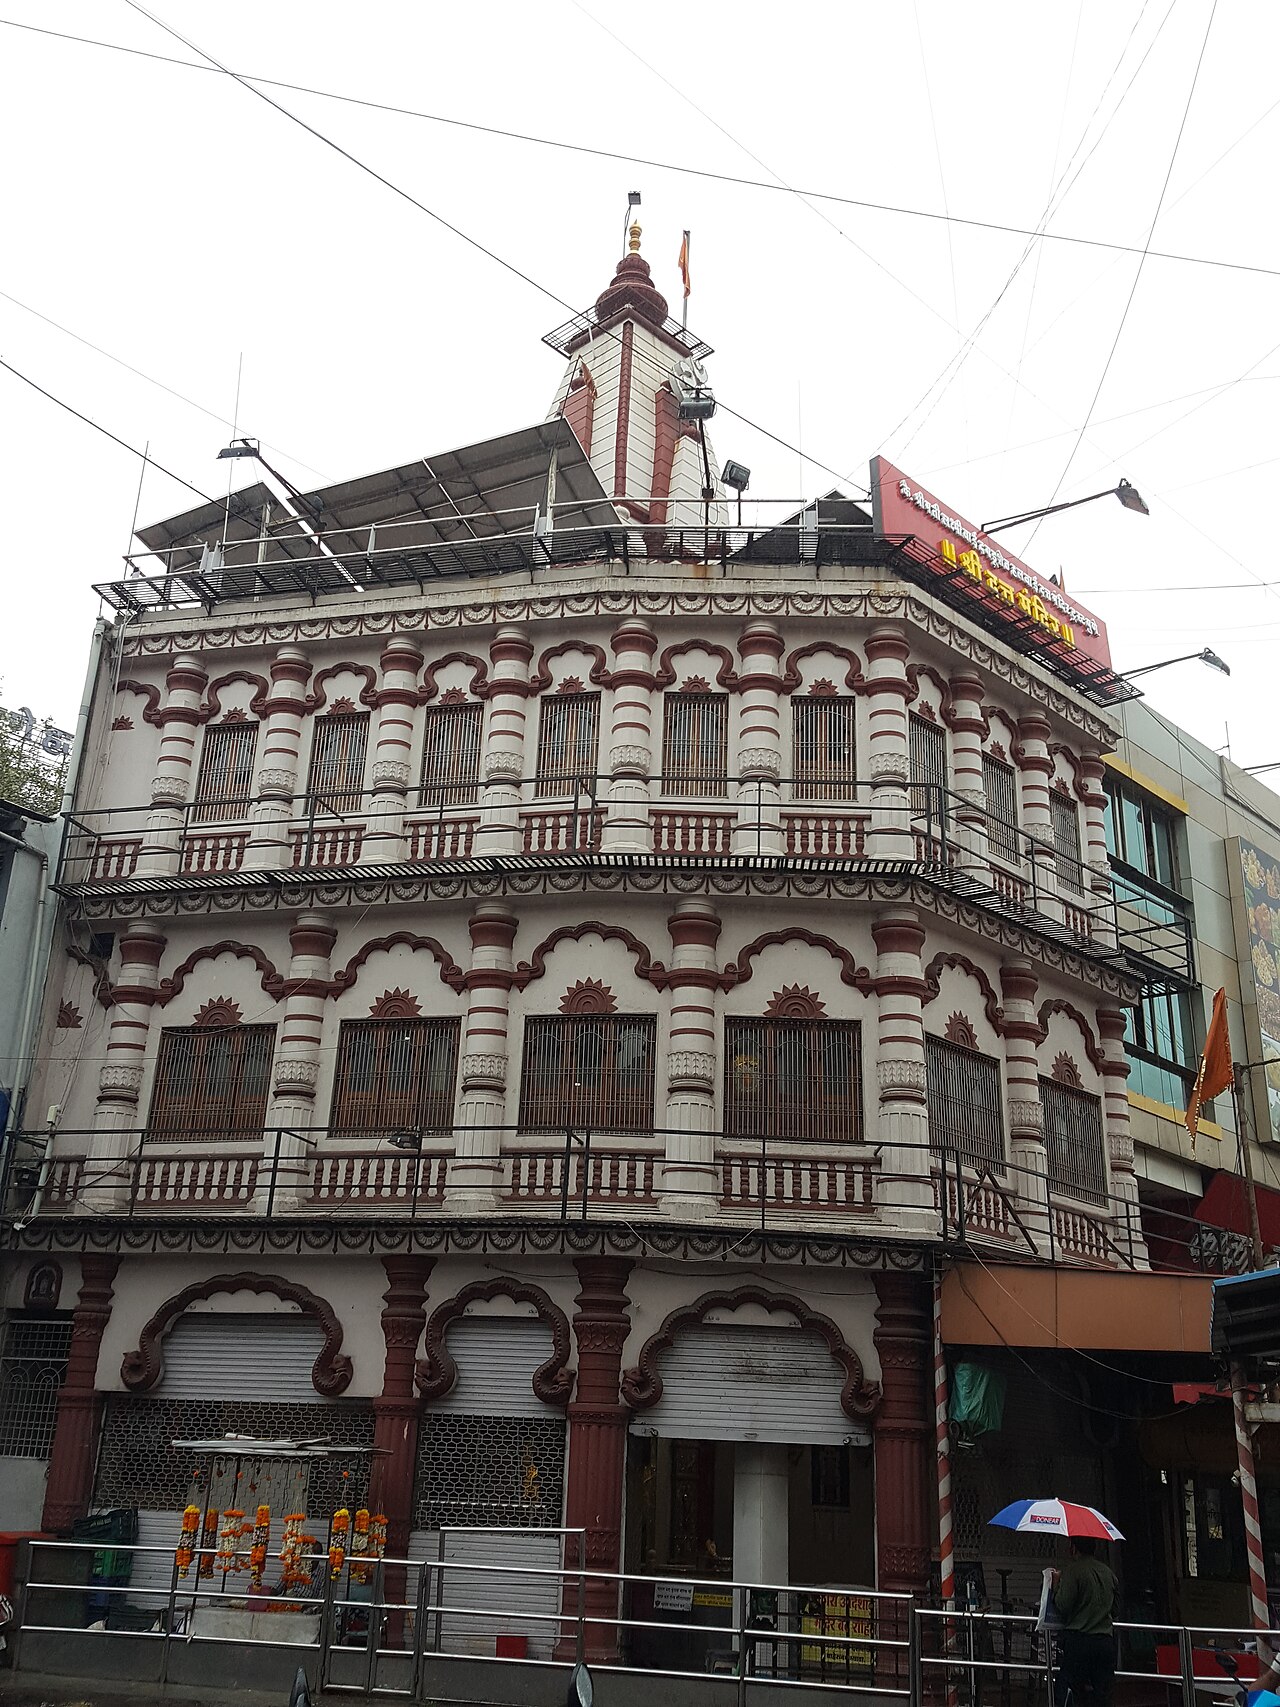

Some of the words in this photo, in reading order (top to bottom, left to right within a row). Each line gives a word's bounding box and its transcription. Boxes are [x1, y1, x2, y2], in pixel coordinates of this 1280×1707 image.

[959, 550, 983, 585] श्री
[984, 570, 1015, 607] दत्त
[1015, 588, 1060, 639] मंदिर
[1035, 1516, 1060, 1525] DONEAR
